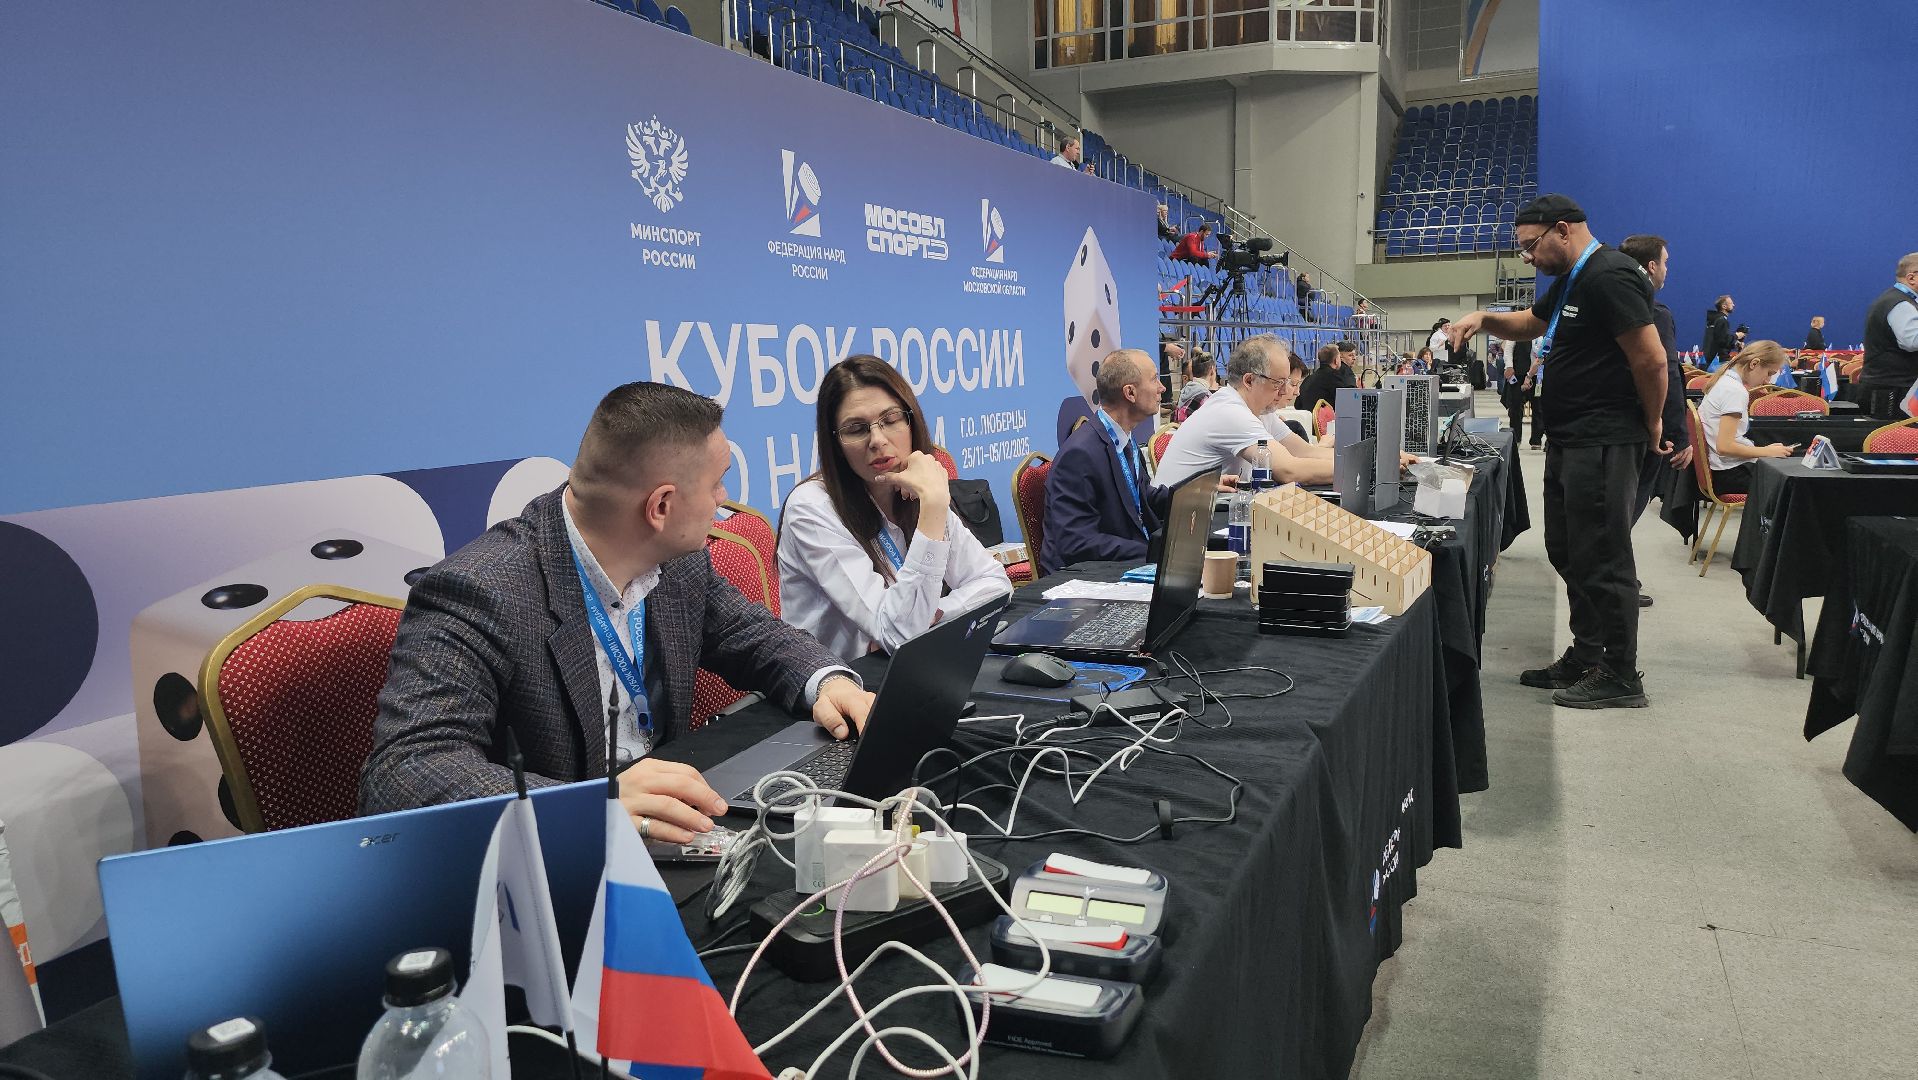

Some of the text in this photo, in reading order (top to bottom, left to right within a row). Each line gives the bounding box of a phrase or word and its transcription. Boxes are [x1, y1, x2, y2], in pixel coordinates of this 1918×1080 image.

[864, 202, 946, 239] МОСОБЛ
[630, 222, 701, 247] МИНСПОРТ
[642, 248, 696, 270] РОССИИ
[767, 240, 847, 265] ФЕДЕРАЦИЯ НАРД
[791, 263, 829, 281] РОССИИ
[970, 266, 1018, 282] ФЕДЕРАЦИЯ НАРД
[963, 280, 1002, 295] МОСКОВСКОЙ
[960, 416, 978, 438] Г.О.
[980, 409, 1027, 435] ЛЮБЕРЦЫ
[360, 833, 400, 848] acer
